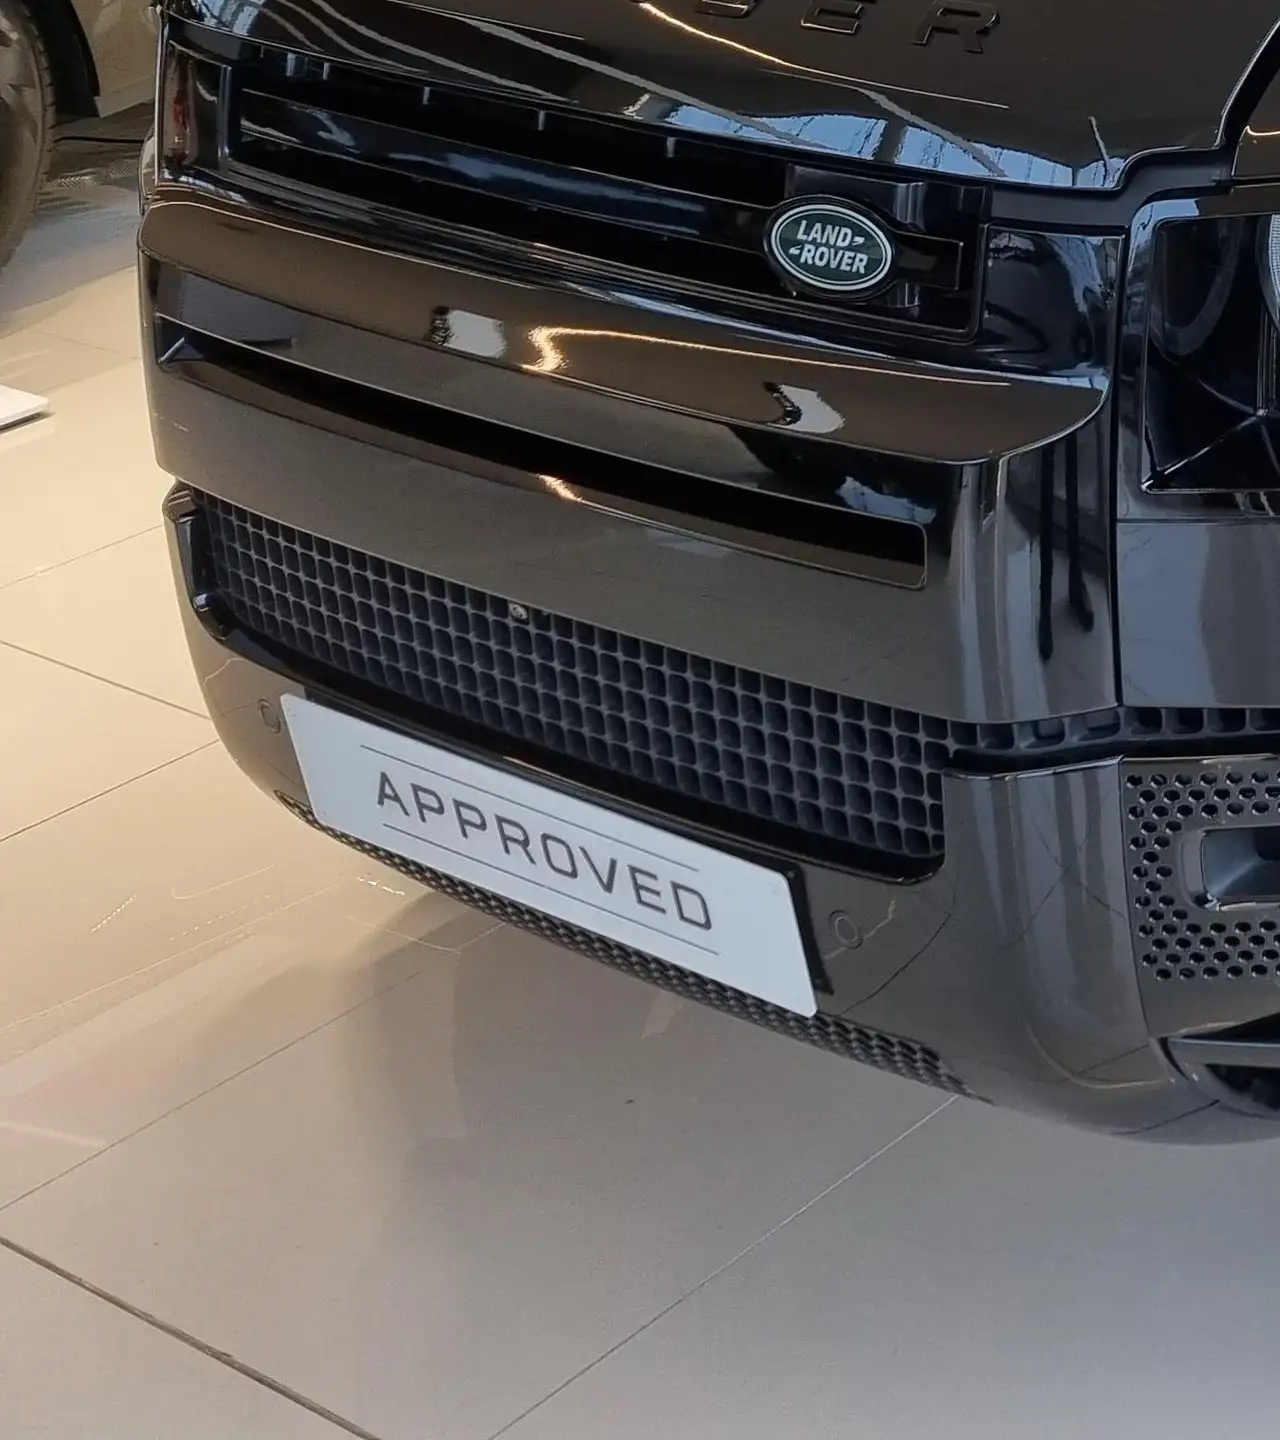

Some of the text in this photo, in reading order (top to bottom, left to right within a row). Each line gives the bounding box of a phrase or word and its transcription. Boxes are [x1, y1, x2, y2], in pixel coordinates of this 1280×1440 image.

[796, 219, 853, 248] LAND
[799, 243, 869, 274] ROVER
[375, 771, 714, 933] APPROVED
